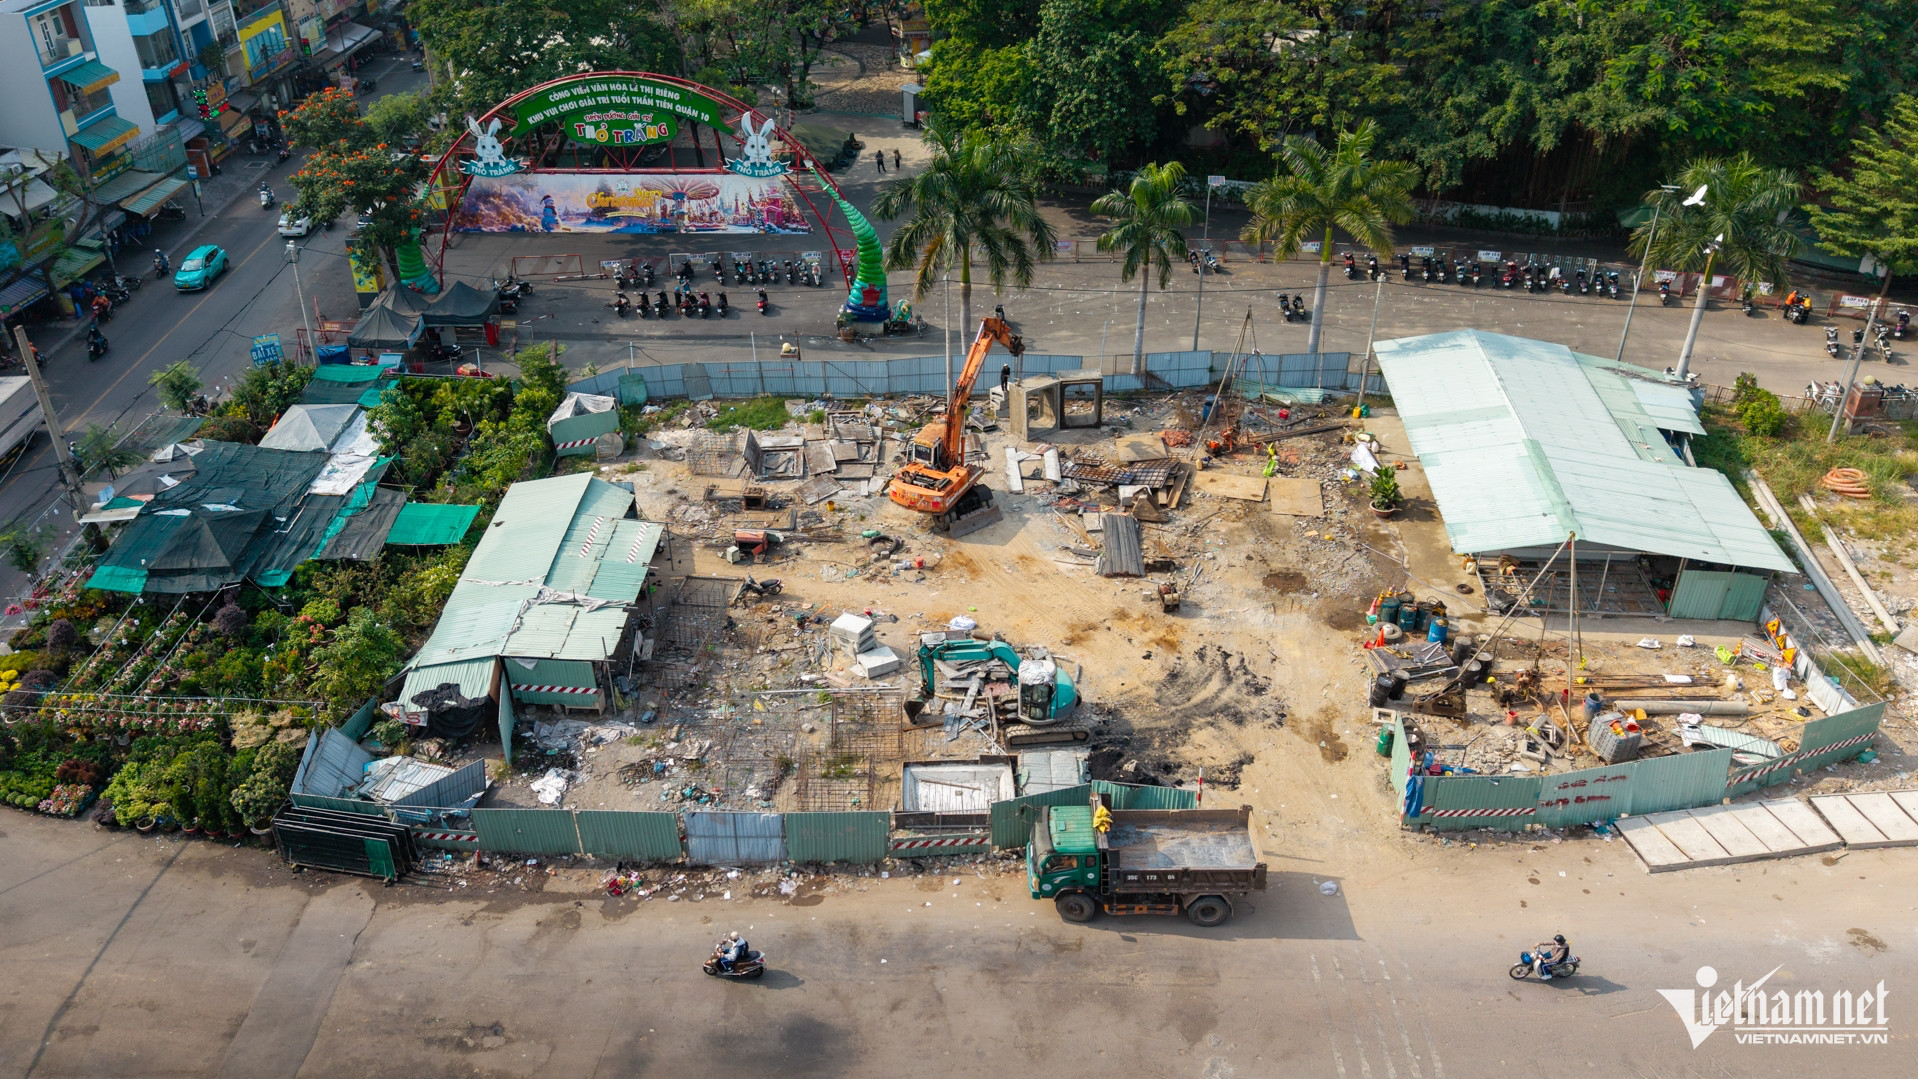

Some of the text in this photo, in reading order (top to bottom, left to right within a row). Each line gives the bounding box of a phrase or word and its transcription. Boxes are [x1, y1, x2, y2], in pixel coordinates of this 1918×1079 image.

[549, 90, 571, 102] CÔNG
[591, 82, 608, 92] VĂN
[609, 82, 628, 91] HÓA
[640, 85, 653, 96] THỊ
[656, 87, 680, 100] RIÊNG
[527, 112, 544, 125] KHU
[544, 106, 559, 118] VUI
[559, 101, 578, 112] CHƠI
[578, 95, 596, 107] GIẢI
[597, 94, 610, 104] TRÍ
[611, 92, 630, 104] TUỔI
[655, 100, 673, 110] TIÊN
[675, 104, 699, 117] QUẬN
[701, 112, 710, 122] 10
[575, 123, 668, 143] THỎ TRẮNG
[471, 165, 515, 176] THỎ TRẮNG
[736, 164, 781, 176] THỎ TRẮNG
[586, 192, 653, 208] Christmas
[633, 187, 663, 200] Merry
[266, 347, 276, 356] XE
